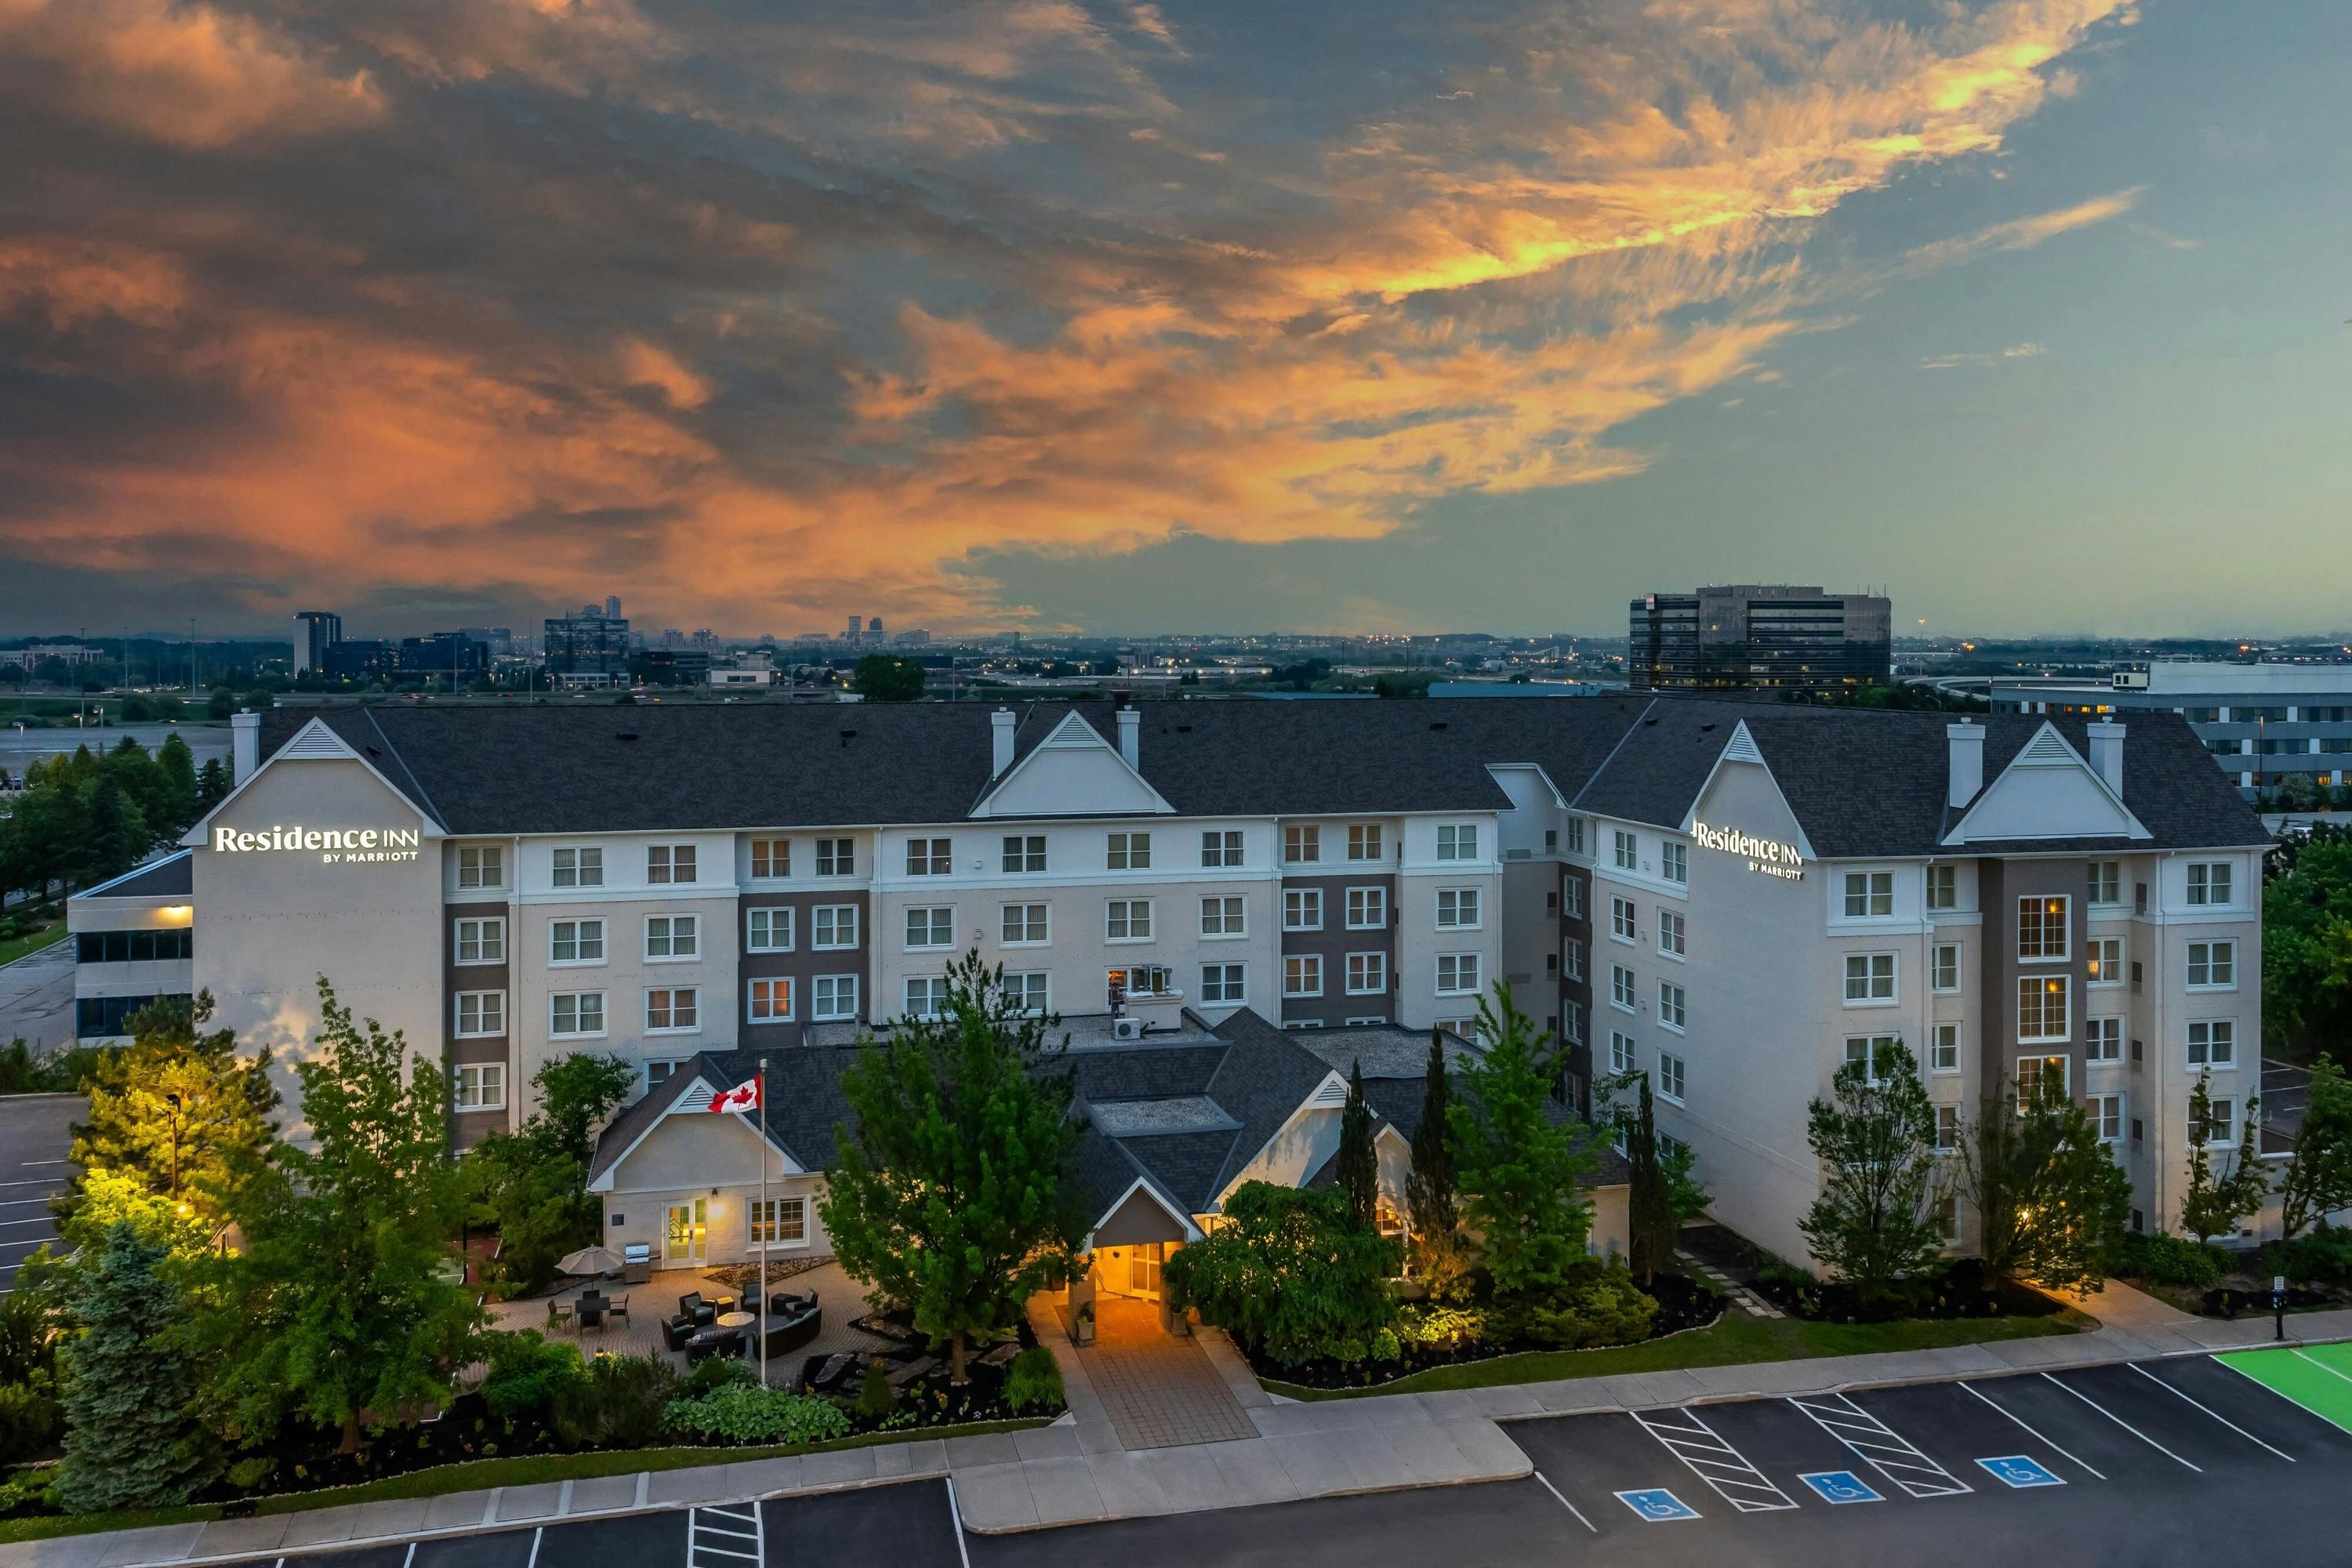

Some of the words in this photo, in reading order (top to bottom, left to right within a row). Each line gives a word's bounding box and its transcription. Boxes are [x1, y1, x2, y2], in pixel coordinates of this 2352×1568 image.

[216, 826, 378, 852] Residence
[383, 829, 419, 848] INN
[1697, 822, 1779, 862] Residence
[1780, 844, 1802, 866] INN
[323, 854, 341, 863] BY
[346, 851, 419, 863] MARRIOTT
[1749, 862, 1759, 872] BY
[1761, 864, 1802, 880] MARRIOTT
